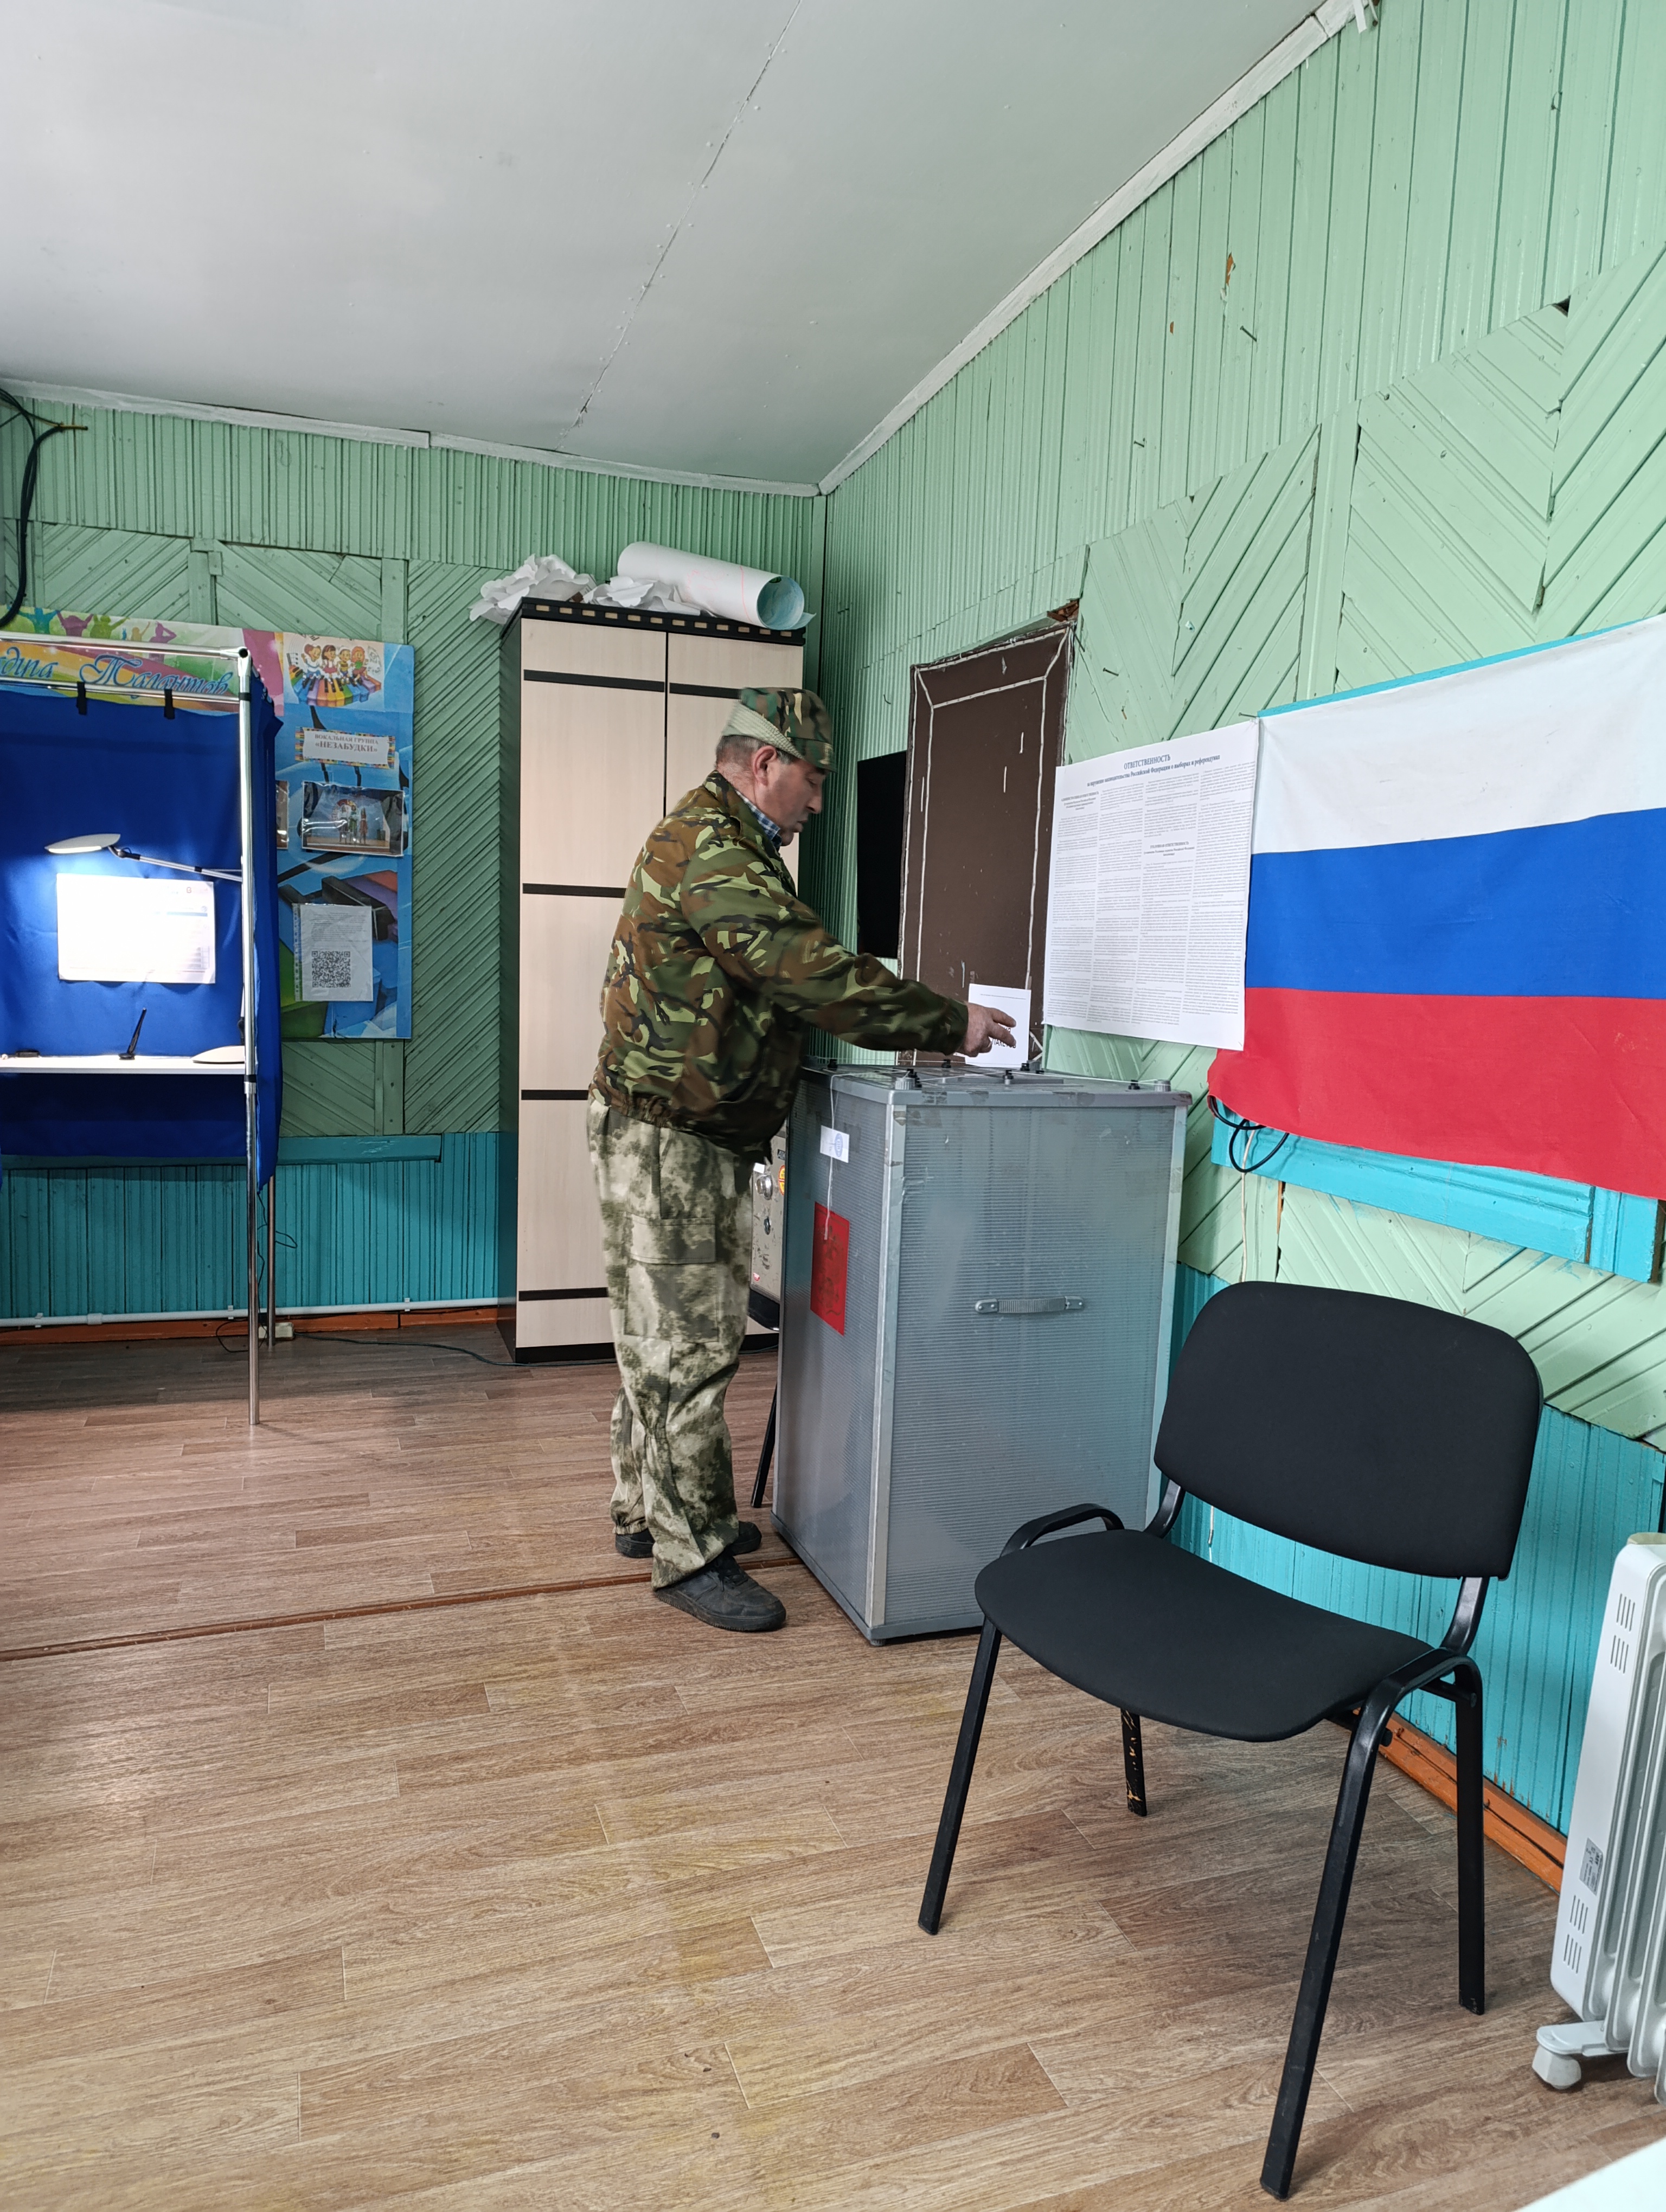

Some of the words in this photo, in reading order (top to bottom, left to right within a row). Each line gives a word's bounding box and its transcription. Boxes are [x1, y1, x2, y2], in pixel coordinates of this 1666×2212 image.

[315, 734, 353, 742] ВОКАЛЬНАЯ
[315, 741, 377, 753] «НЕЗАБУДКИ»
[1124, 754, 1171, 769] ОТВЕТСТВЕННОСТЬ
[1130, 768, 1150, 777] Российской
[1150, 765, 1170, 774] Федерации
[1194, 755, 1220, 767] референдумах
